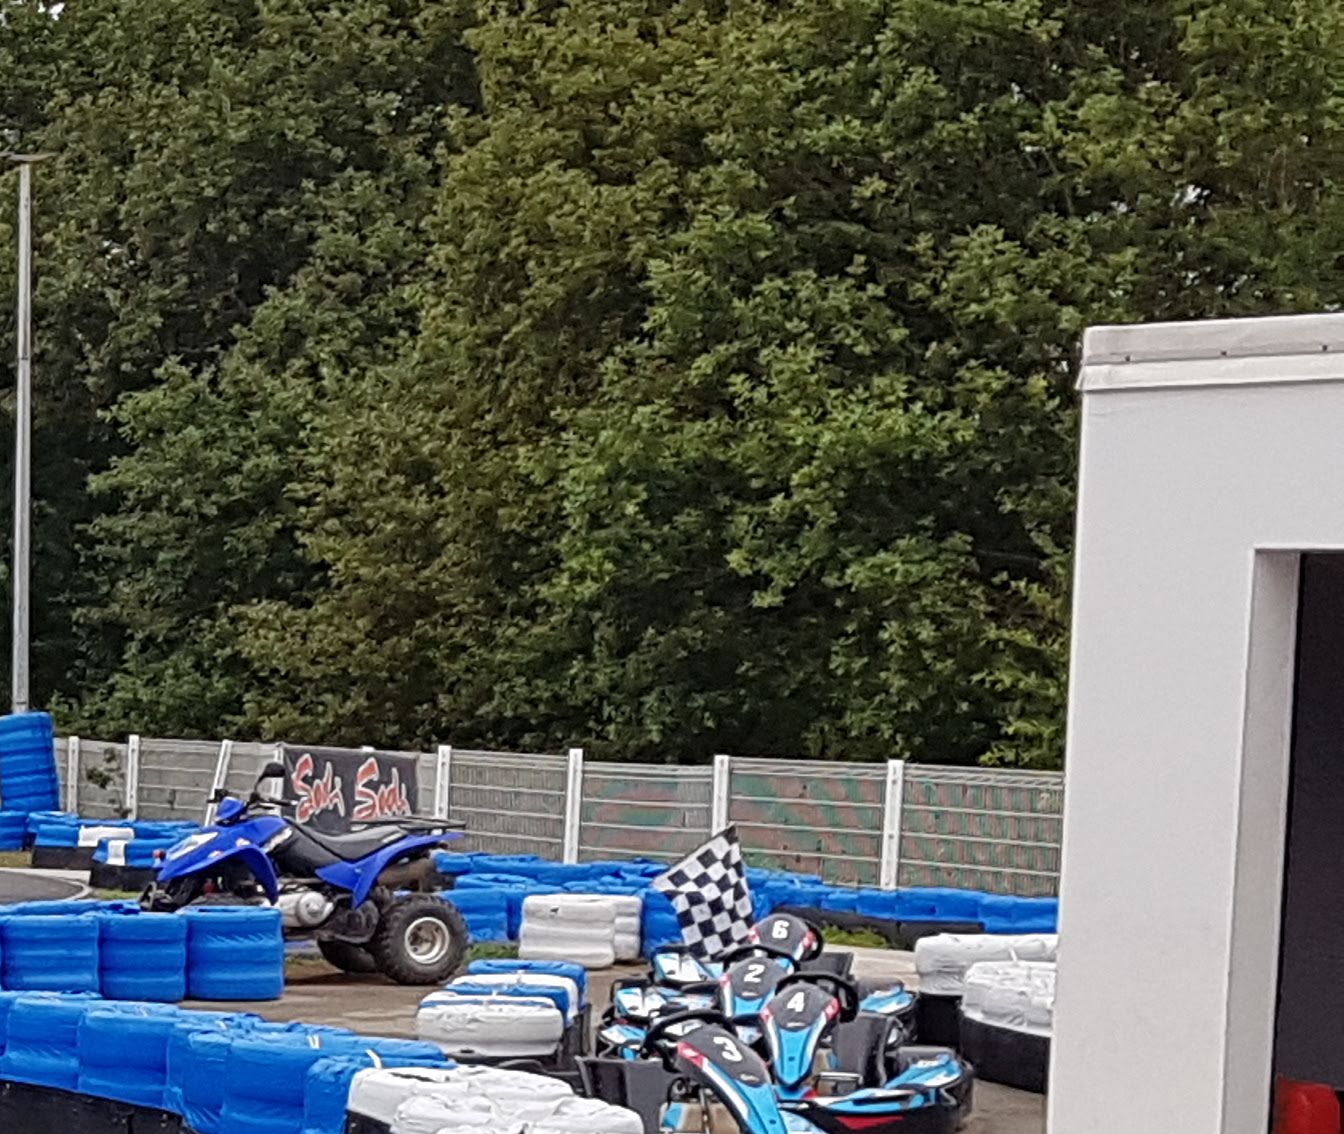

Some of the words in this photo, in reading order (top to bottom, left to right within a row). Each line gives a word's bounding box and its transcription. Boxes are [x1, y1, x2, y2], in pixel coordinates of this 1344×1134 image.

[771, 919, 790, 939] 6
[743, 963, 765, 983] 2
[786, 991, 806, 1012] 4
[712, 1036, 743, 1062] 3
